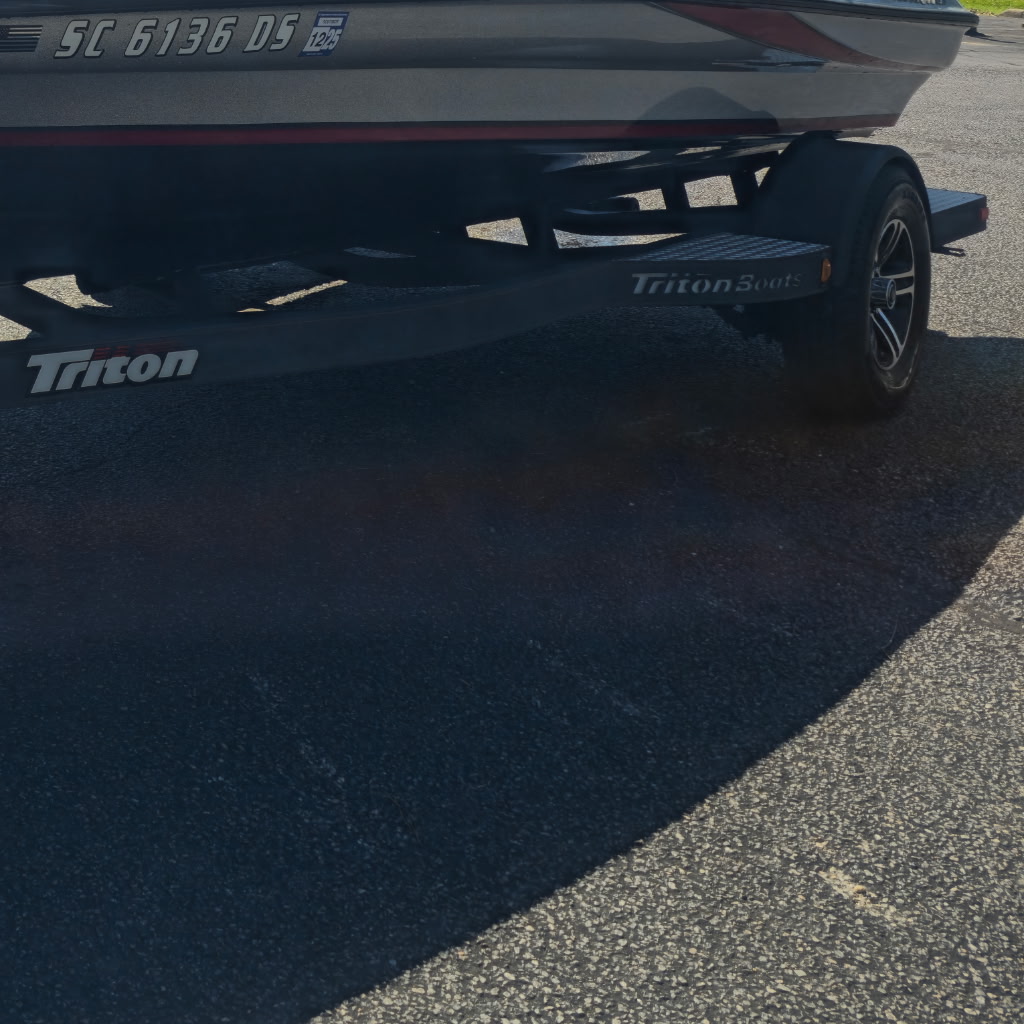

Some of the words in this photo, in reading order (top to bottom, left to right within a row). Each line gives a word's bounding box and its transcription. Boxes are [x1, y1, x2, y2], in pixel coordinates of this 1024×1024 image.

[53, 19, 116, 59] SC
[123, 16, 238, 57] 6136
[242, 13, 301, 53] DS
[632, 272, 733, 295] Triton
[735, 273, 804, 292] Boats
[27, 348, 199, 394] Triton
